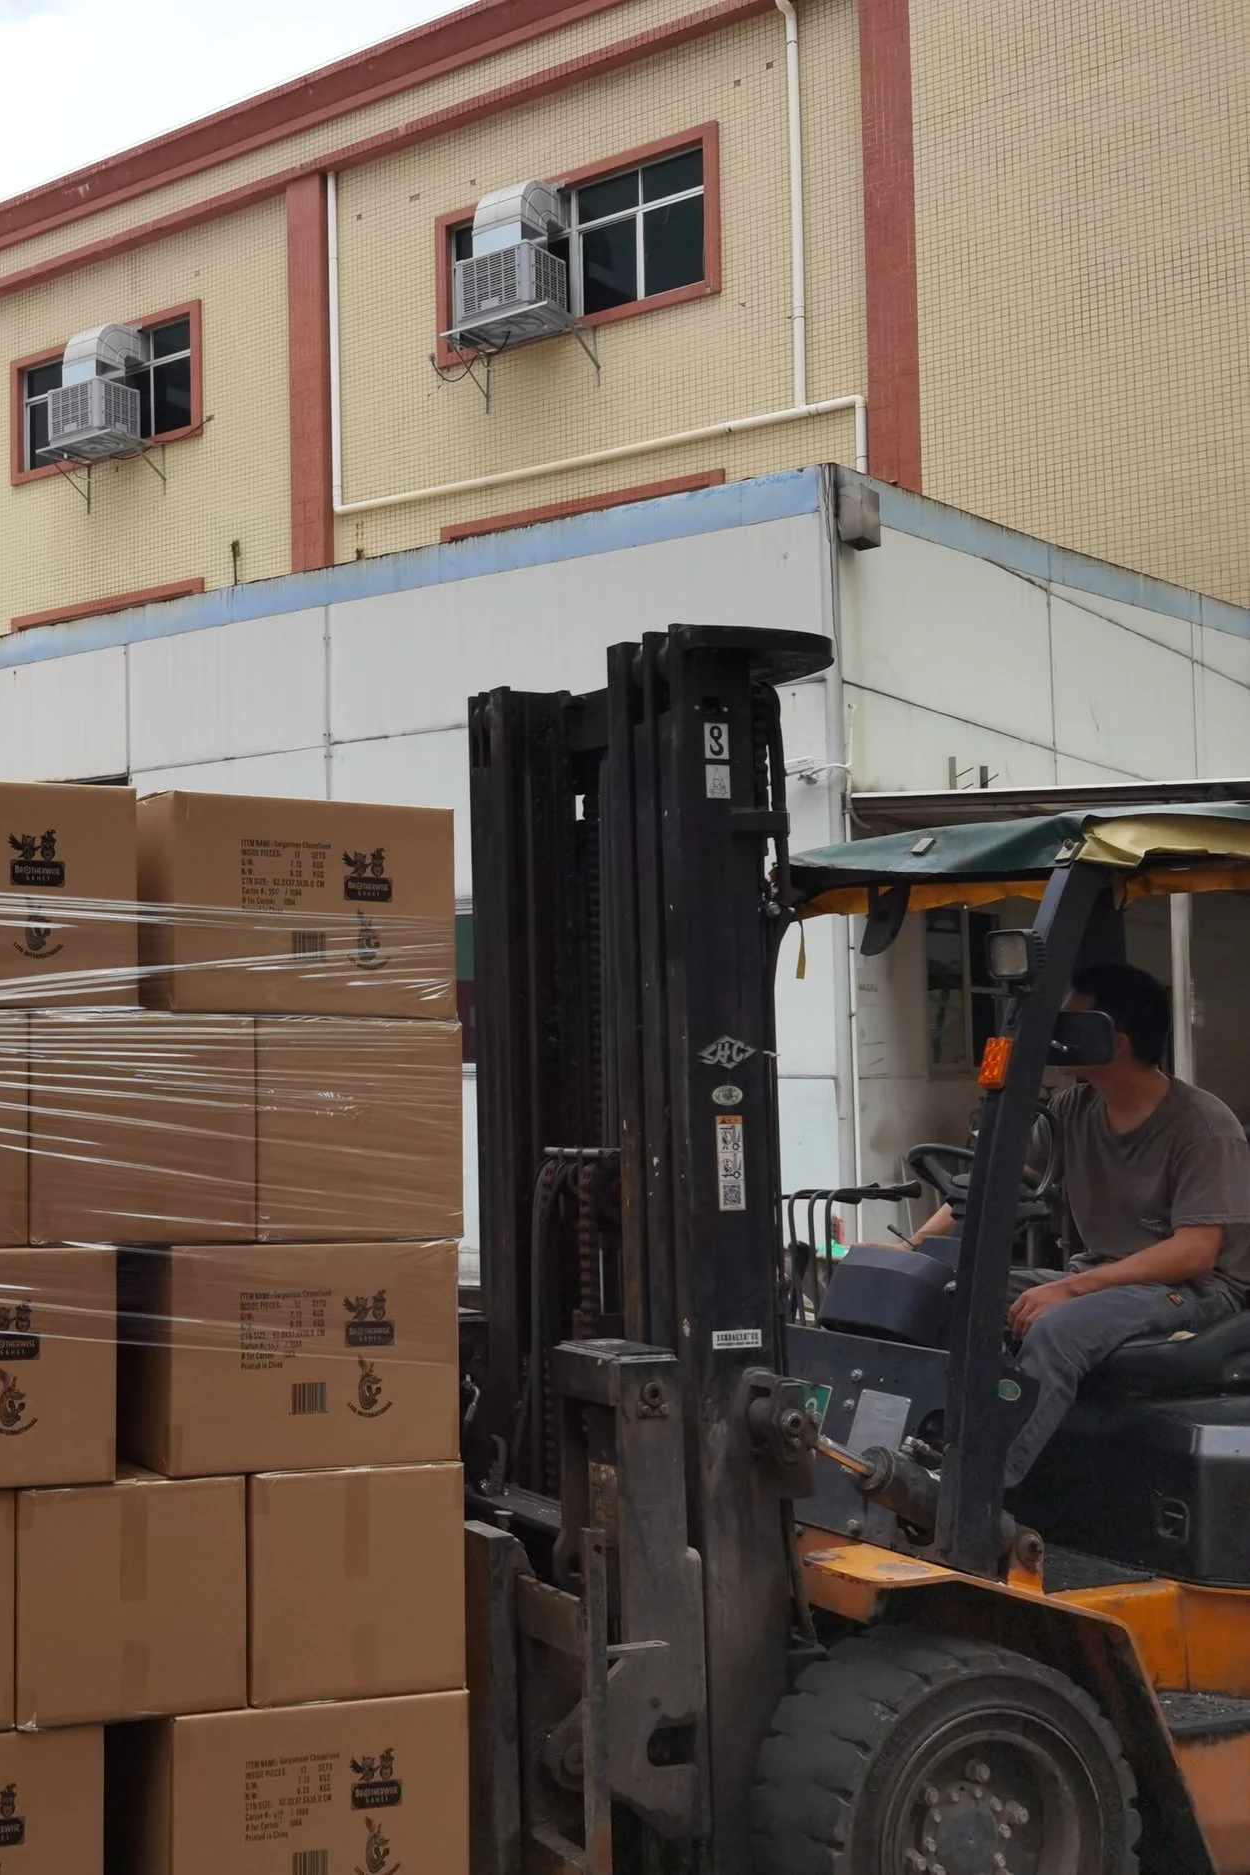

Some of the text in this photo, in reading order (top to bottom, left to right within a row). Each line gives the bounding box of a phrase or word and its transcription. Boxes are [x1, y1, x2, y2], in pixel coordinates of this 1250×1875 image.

[14, 865, 61, 876] BROTHERWISE
[347, 881, 389, 892] BROTHERWISE
[355, 1786, 398, 1798] BROTHERWISE
[273, 1830, 288, 1840] China
